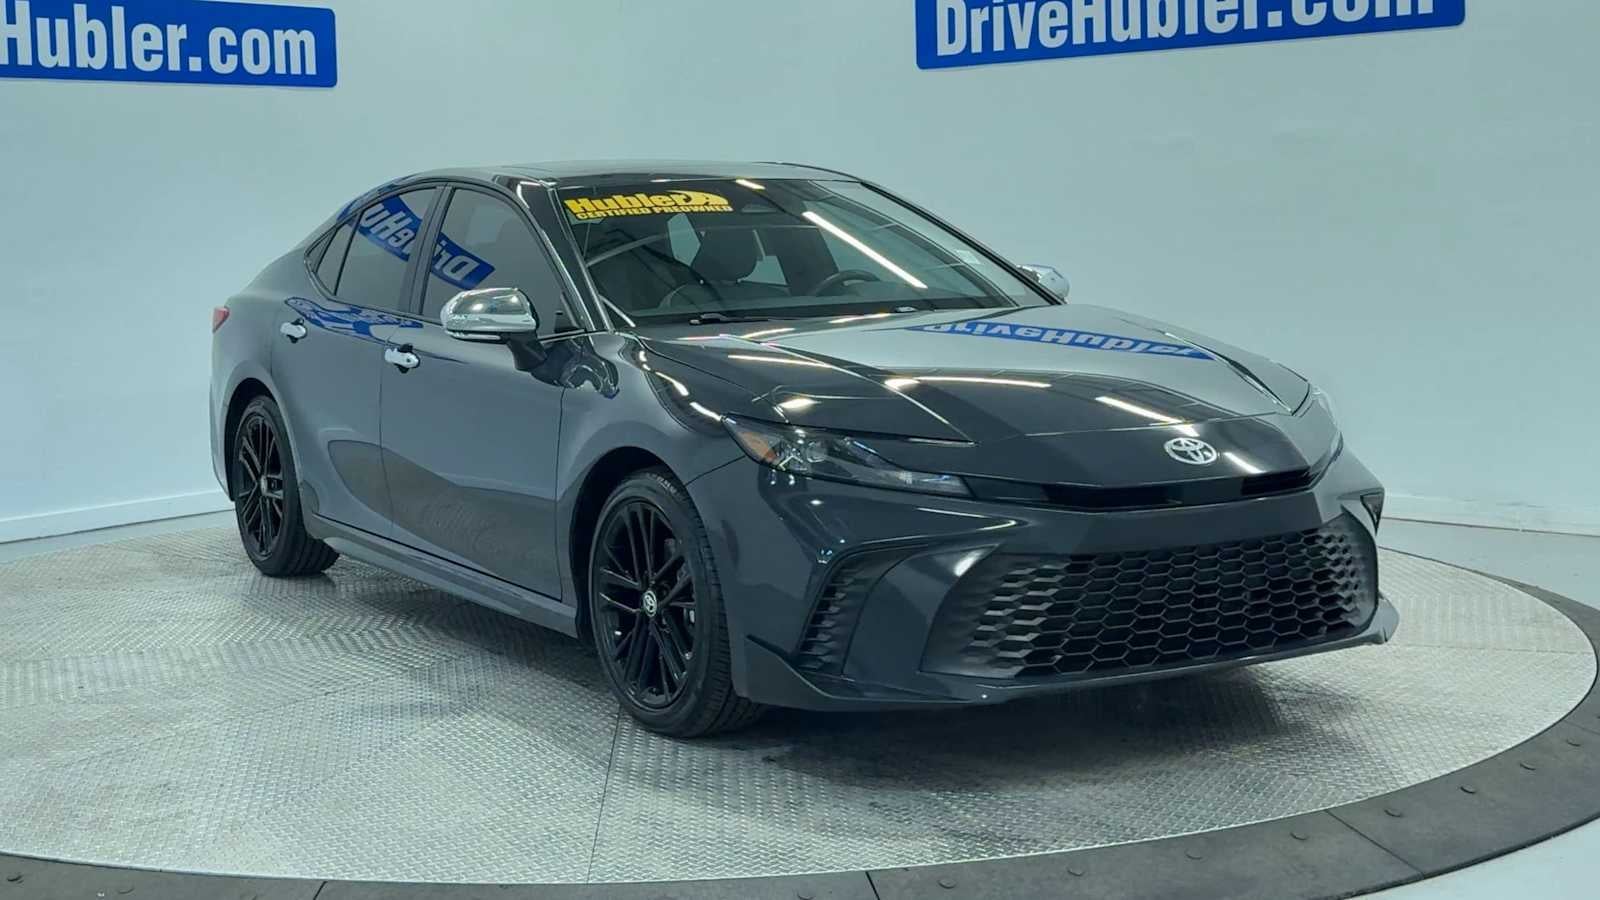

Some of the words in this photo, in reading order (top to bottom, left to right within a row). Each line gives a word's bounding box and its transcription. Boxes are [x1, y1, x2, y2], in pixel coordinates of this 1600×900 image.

[936, 0, 1434, 56] DriveHubler.c
[564, 192, 692, 214] Hubler
[576, 206, 650, 220] CERTIFIED
